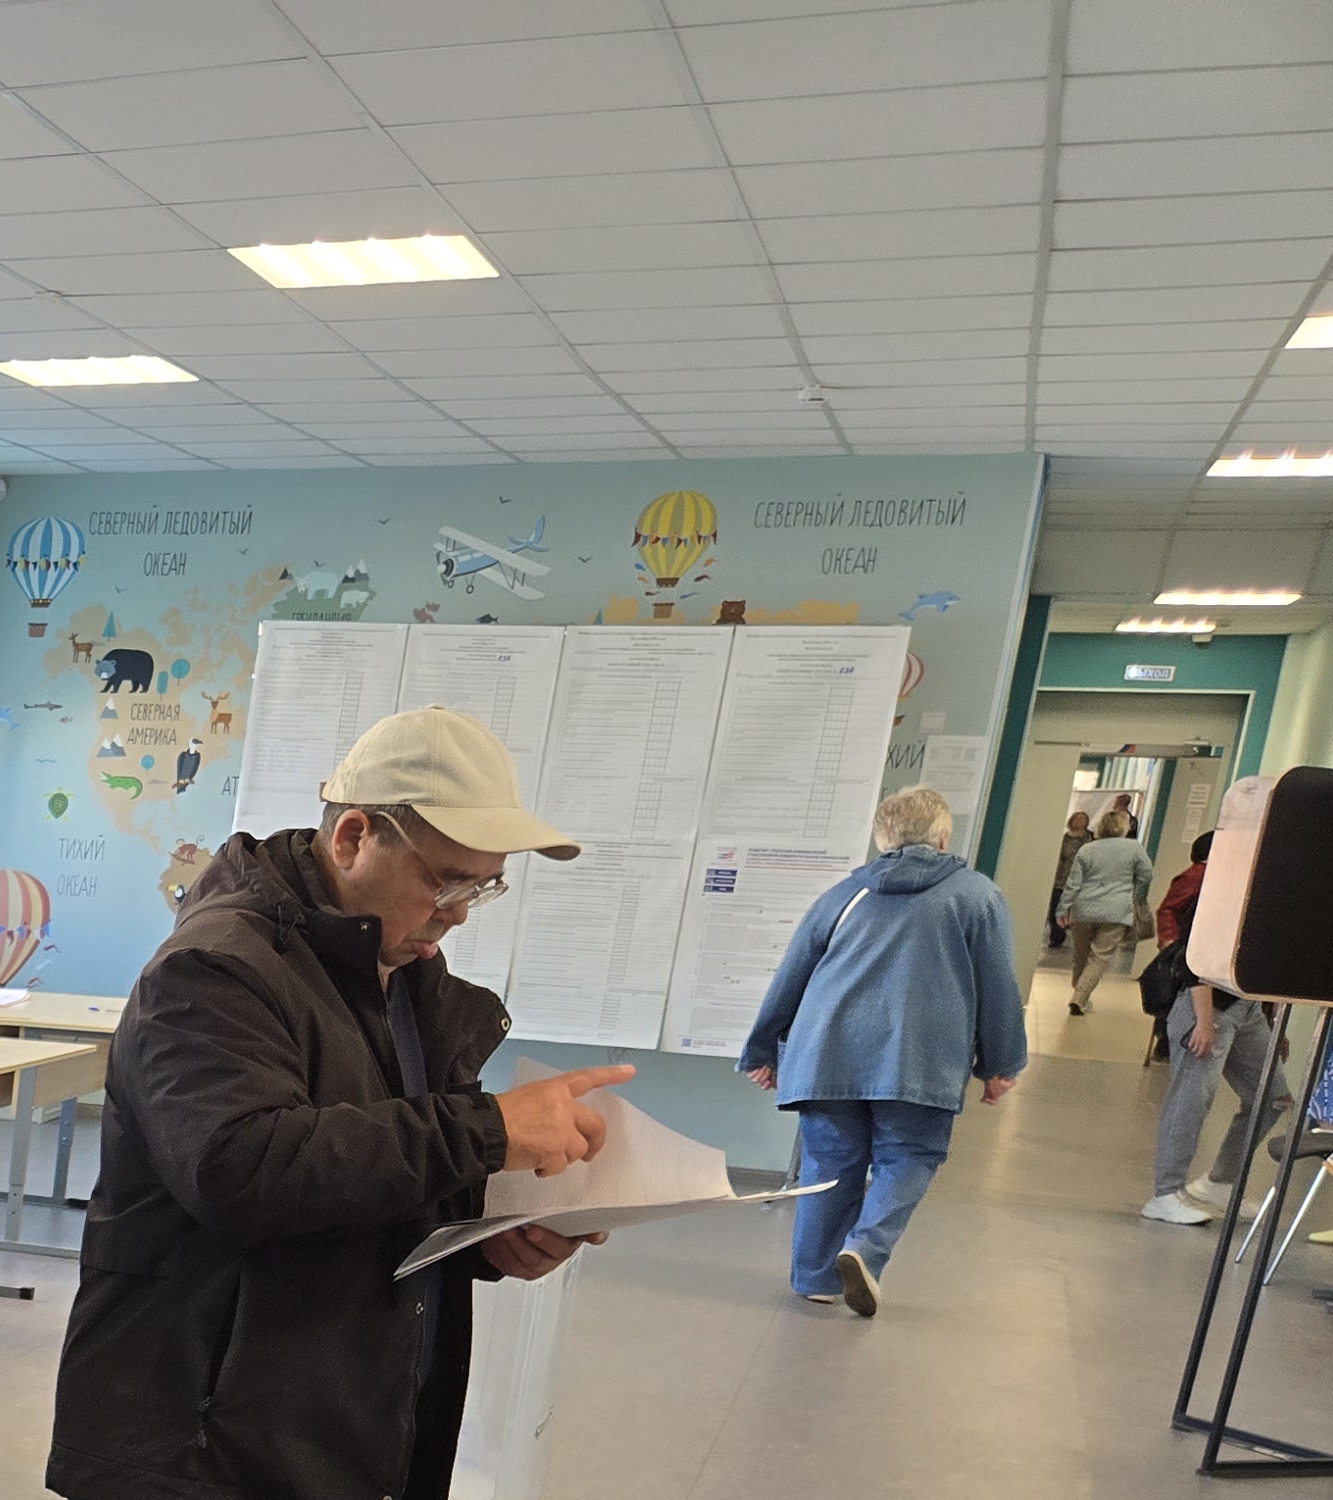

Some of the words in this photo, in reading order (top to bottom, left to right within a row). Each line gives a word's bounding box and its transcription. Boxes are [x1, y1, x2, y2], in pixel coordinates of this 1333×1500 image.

[89, 504, 159, 535] СЕВЕРНЫЙ
[162, 504, 253, 535] ЛЕДОВИТЫЙ
[754, 492, 845, 529] СЕВЕРНЫЙ
[847, 490, 966, 528] ЛЕДОВИТЫЙ
[144, 552, 187, 576] ОКЕАН
[821, 547, 878, 575] ОКЕАН
[130, 703, 181, 721] СЕВЕРНАЯ
[126, 727, 177, 746] АМЕРИКА
[59, 834, 105, 861] ТИХИЙ
[57, 874, 98, 897] ОКЕАН
